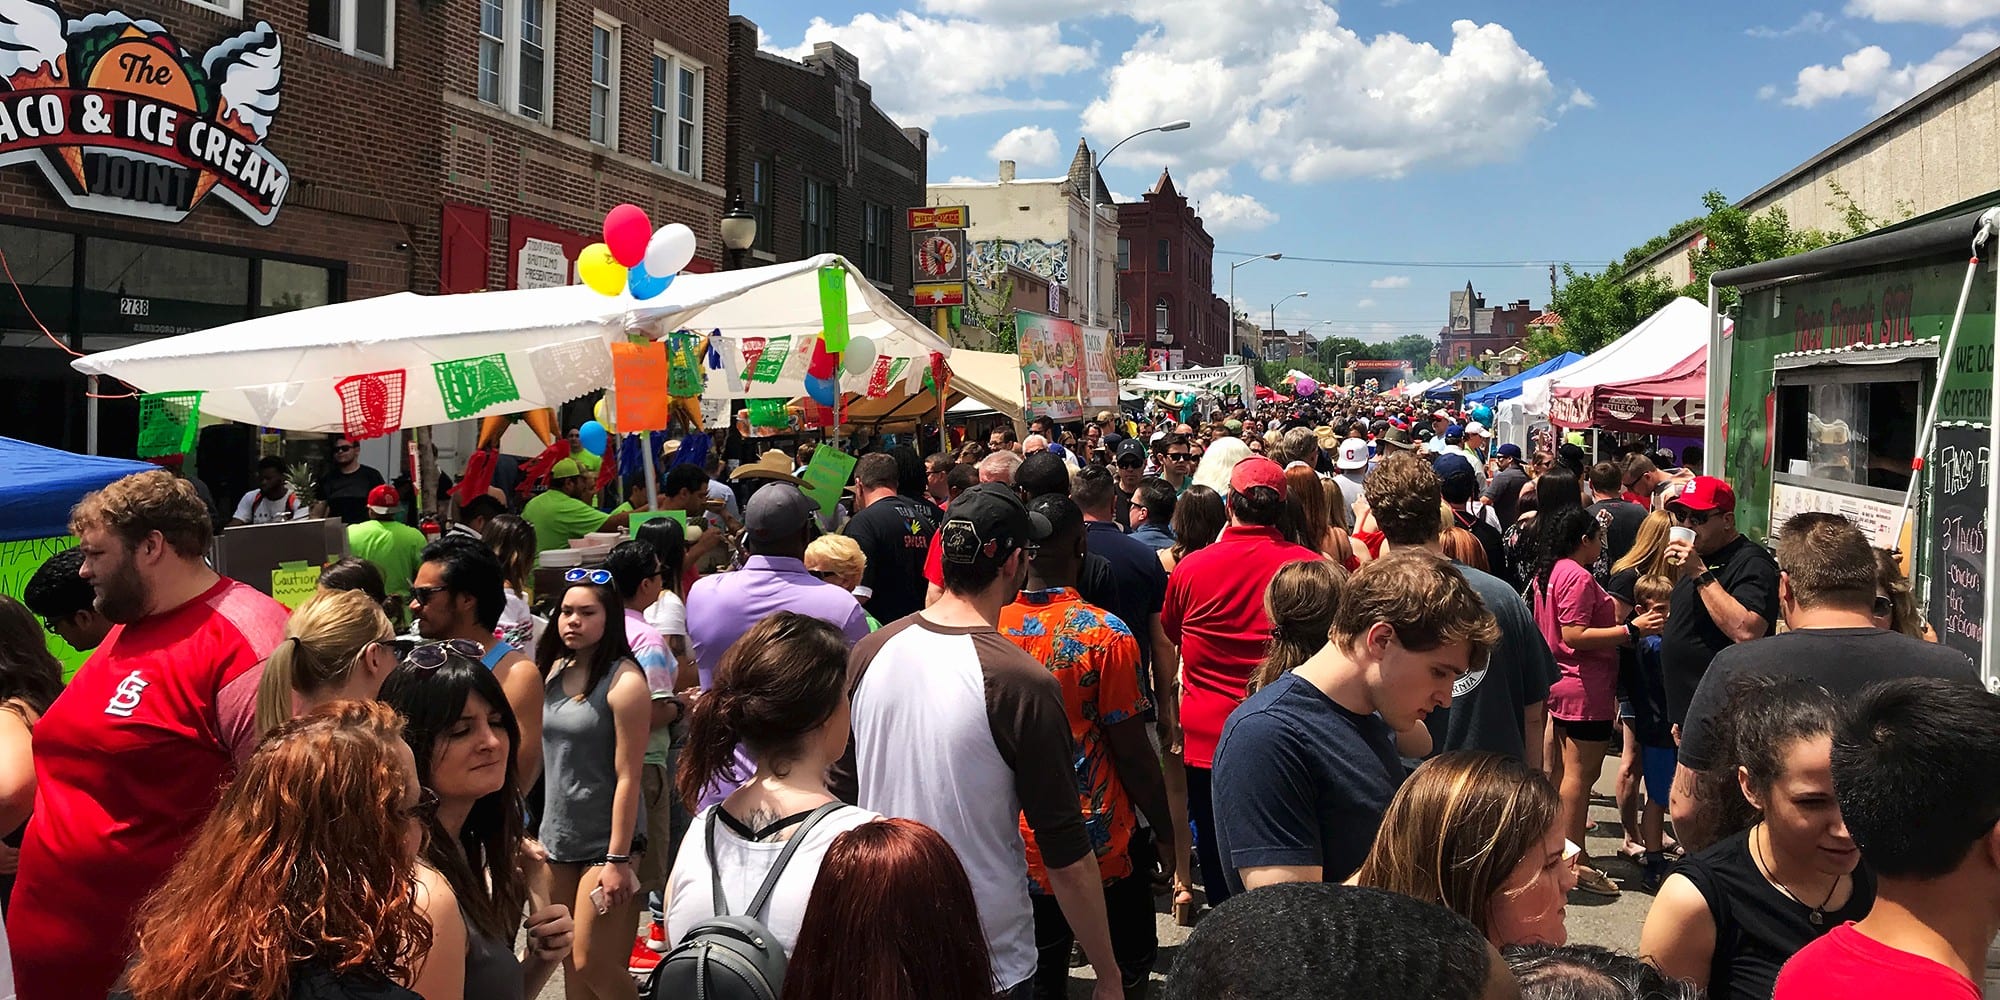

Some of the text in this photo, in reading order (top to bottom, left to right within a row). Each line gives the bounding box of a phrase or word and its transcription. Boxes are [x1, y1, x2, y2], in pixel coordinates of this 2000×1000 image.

[119, 52, 173, 85] The
[81, 94, 112, 134] &
[127, 99, 178, 147] ICE
[189, 121, 288, 205] CREAM
[92, 153, 190, 207] JOINT
[527, 253, 558, 270] BAUTIZMO
[122, 299, 148, 314] 2738
[1829, 296, 1876, 349] Truck
[1956, 345, 1974, 374] WE
[1602, 403, 1625, 411] KETTLE
[1346, 449, 1355, 460] C
[1941, 445, 1974, 495] TACO
[1942, 517, 1952, 551] 3
